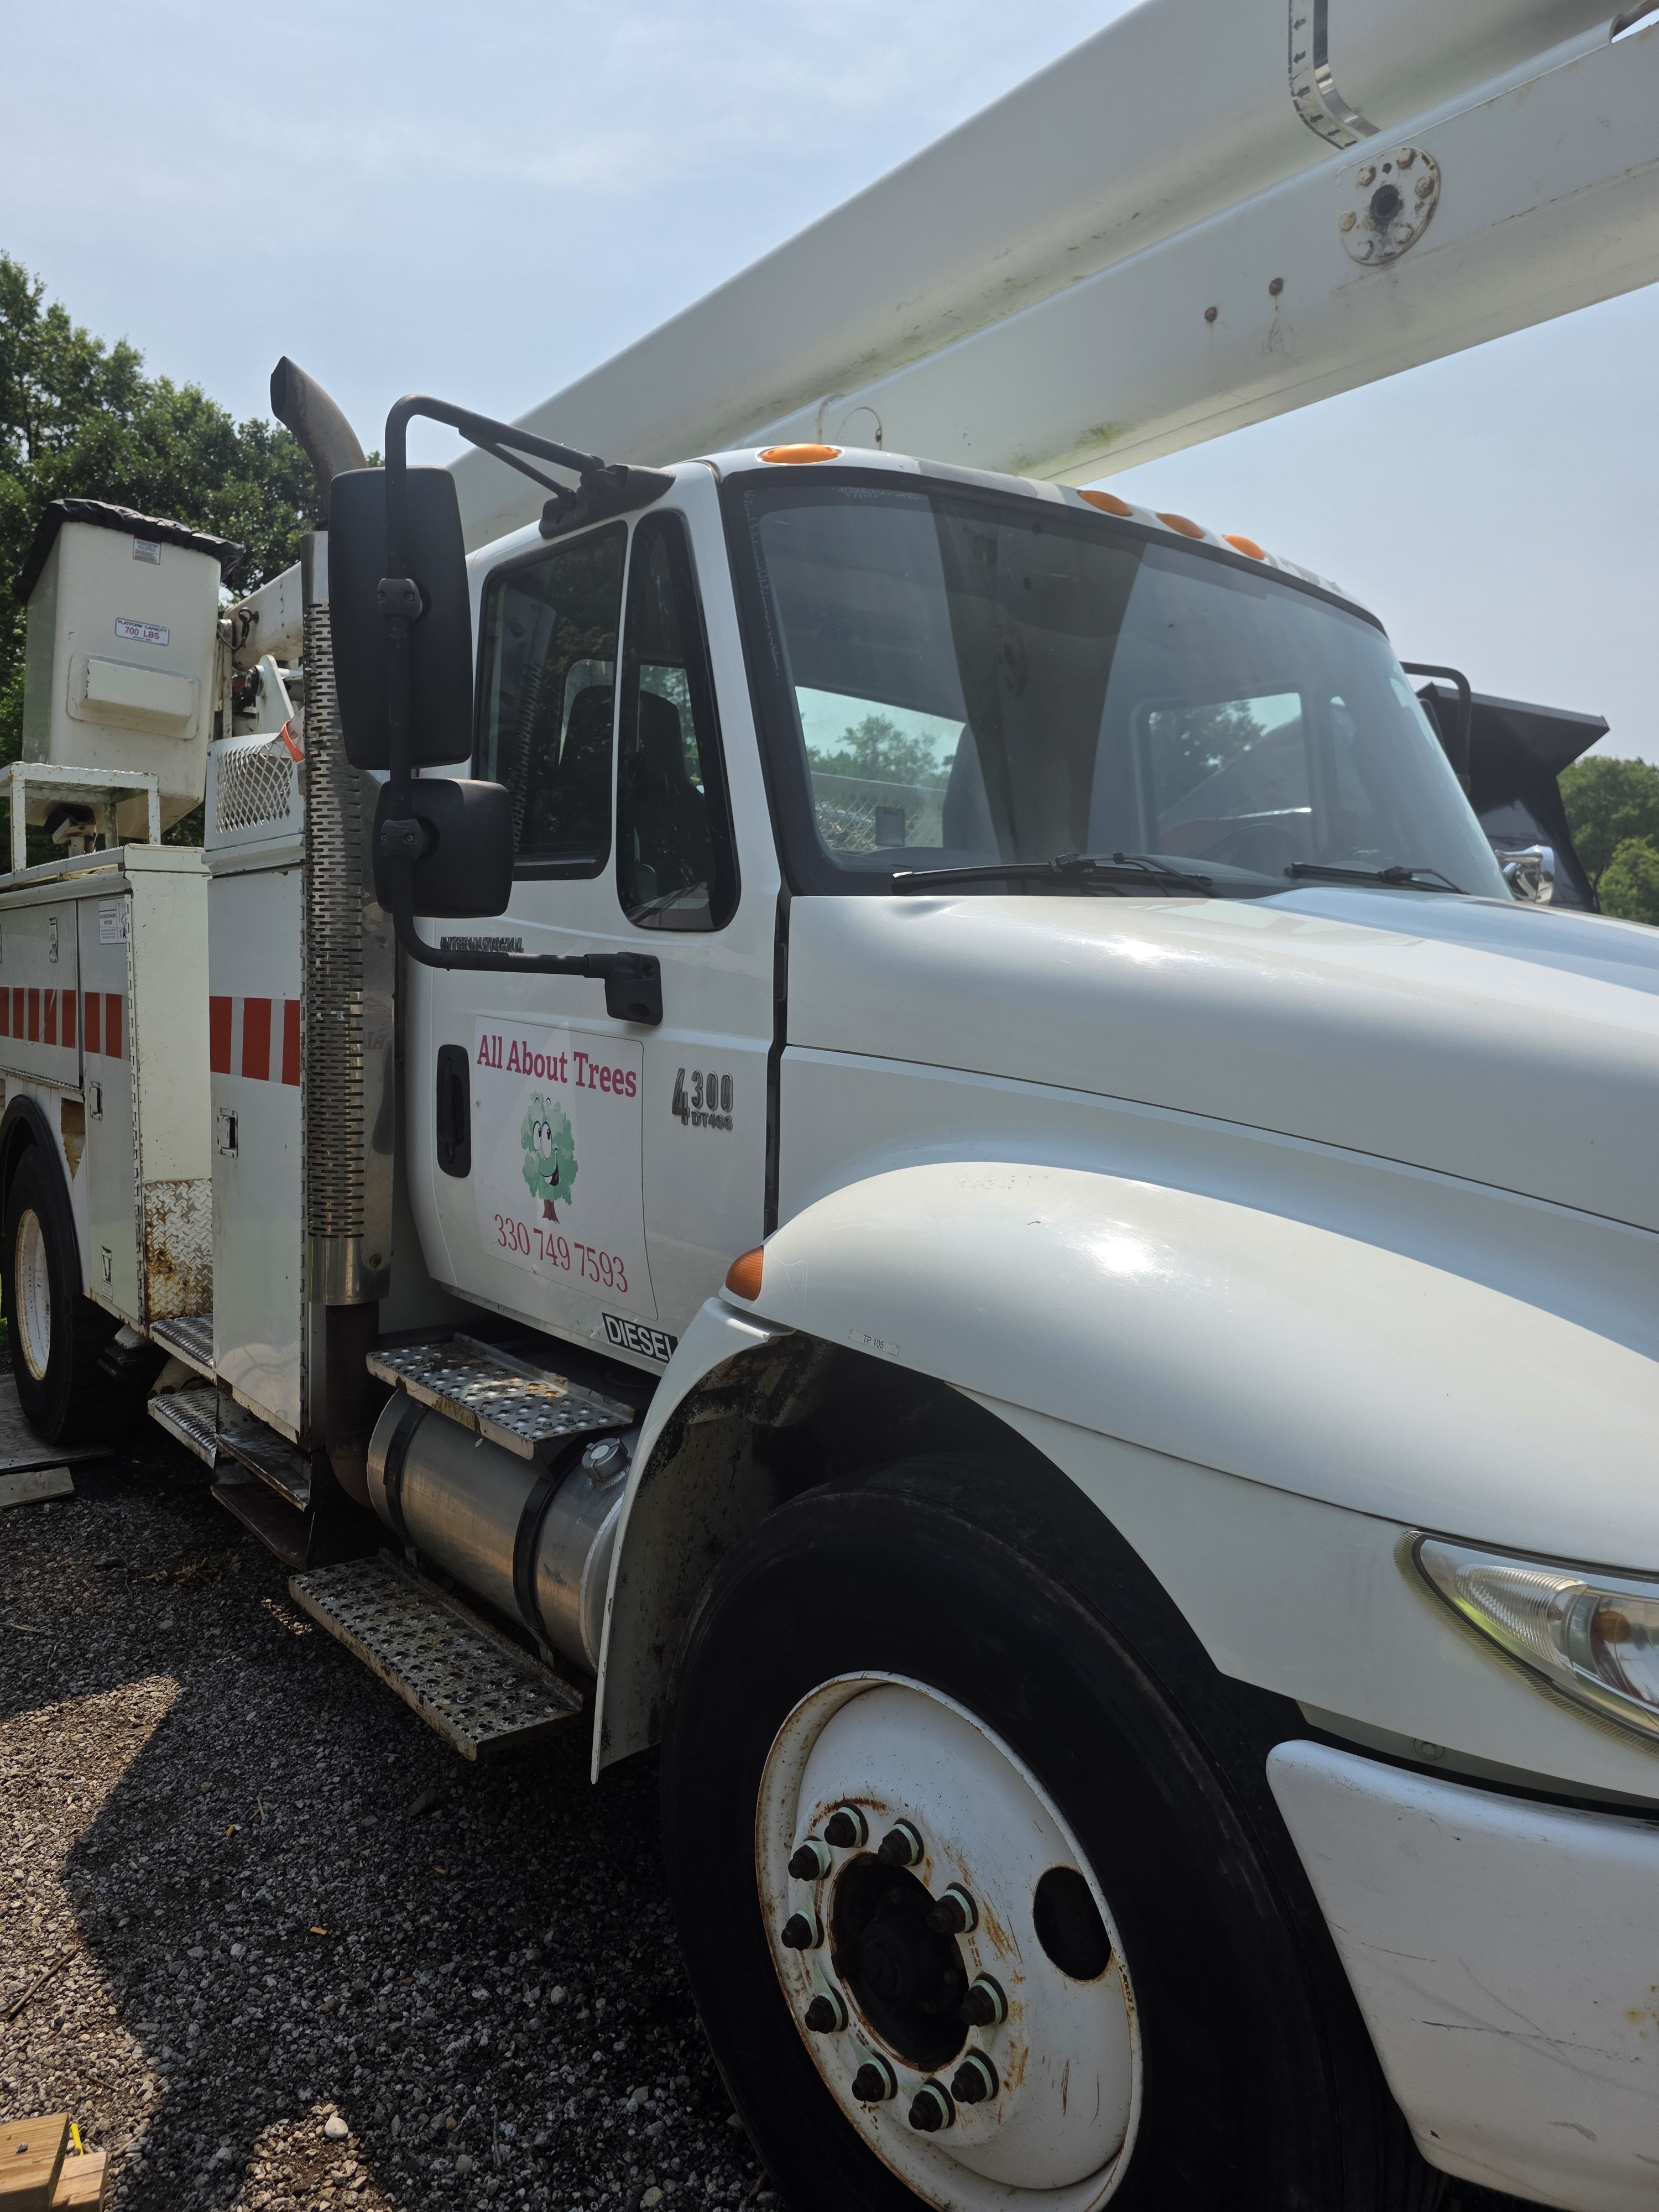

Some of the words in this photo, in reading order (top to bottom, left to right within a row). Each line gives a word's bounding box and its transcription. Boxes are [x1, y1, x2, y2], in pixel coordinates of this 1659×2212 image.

[118, 620, 143, 628] PLATFORM
[125, 626, 139, 636] 700
[143, 630, 160, 640] LBS
[477, 1035, 503, 1070] All
[506, 1040, 568, 1083] About
[573, 1051, 637, 1098] Trees
[672, 1068, 733, 1125] 4300
[691, 1111, 733, 1131] DT466
[494, 1214, 530, 1256] 330
[533, 1227, 571, 1271] 749
[574, 1242, 628, 1293] 7593
[863, 1334, 872, 1344] TP
[873, 1338, 885, 1349] 105
